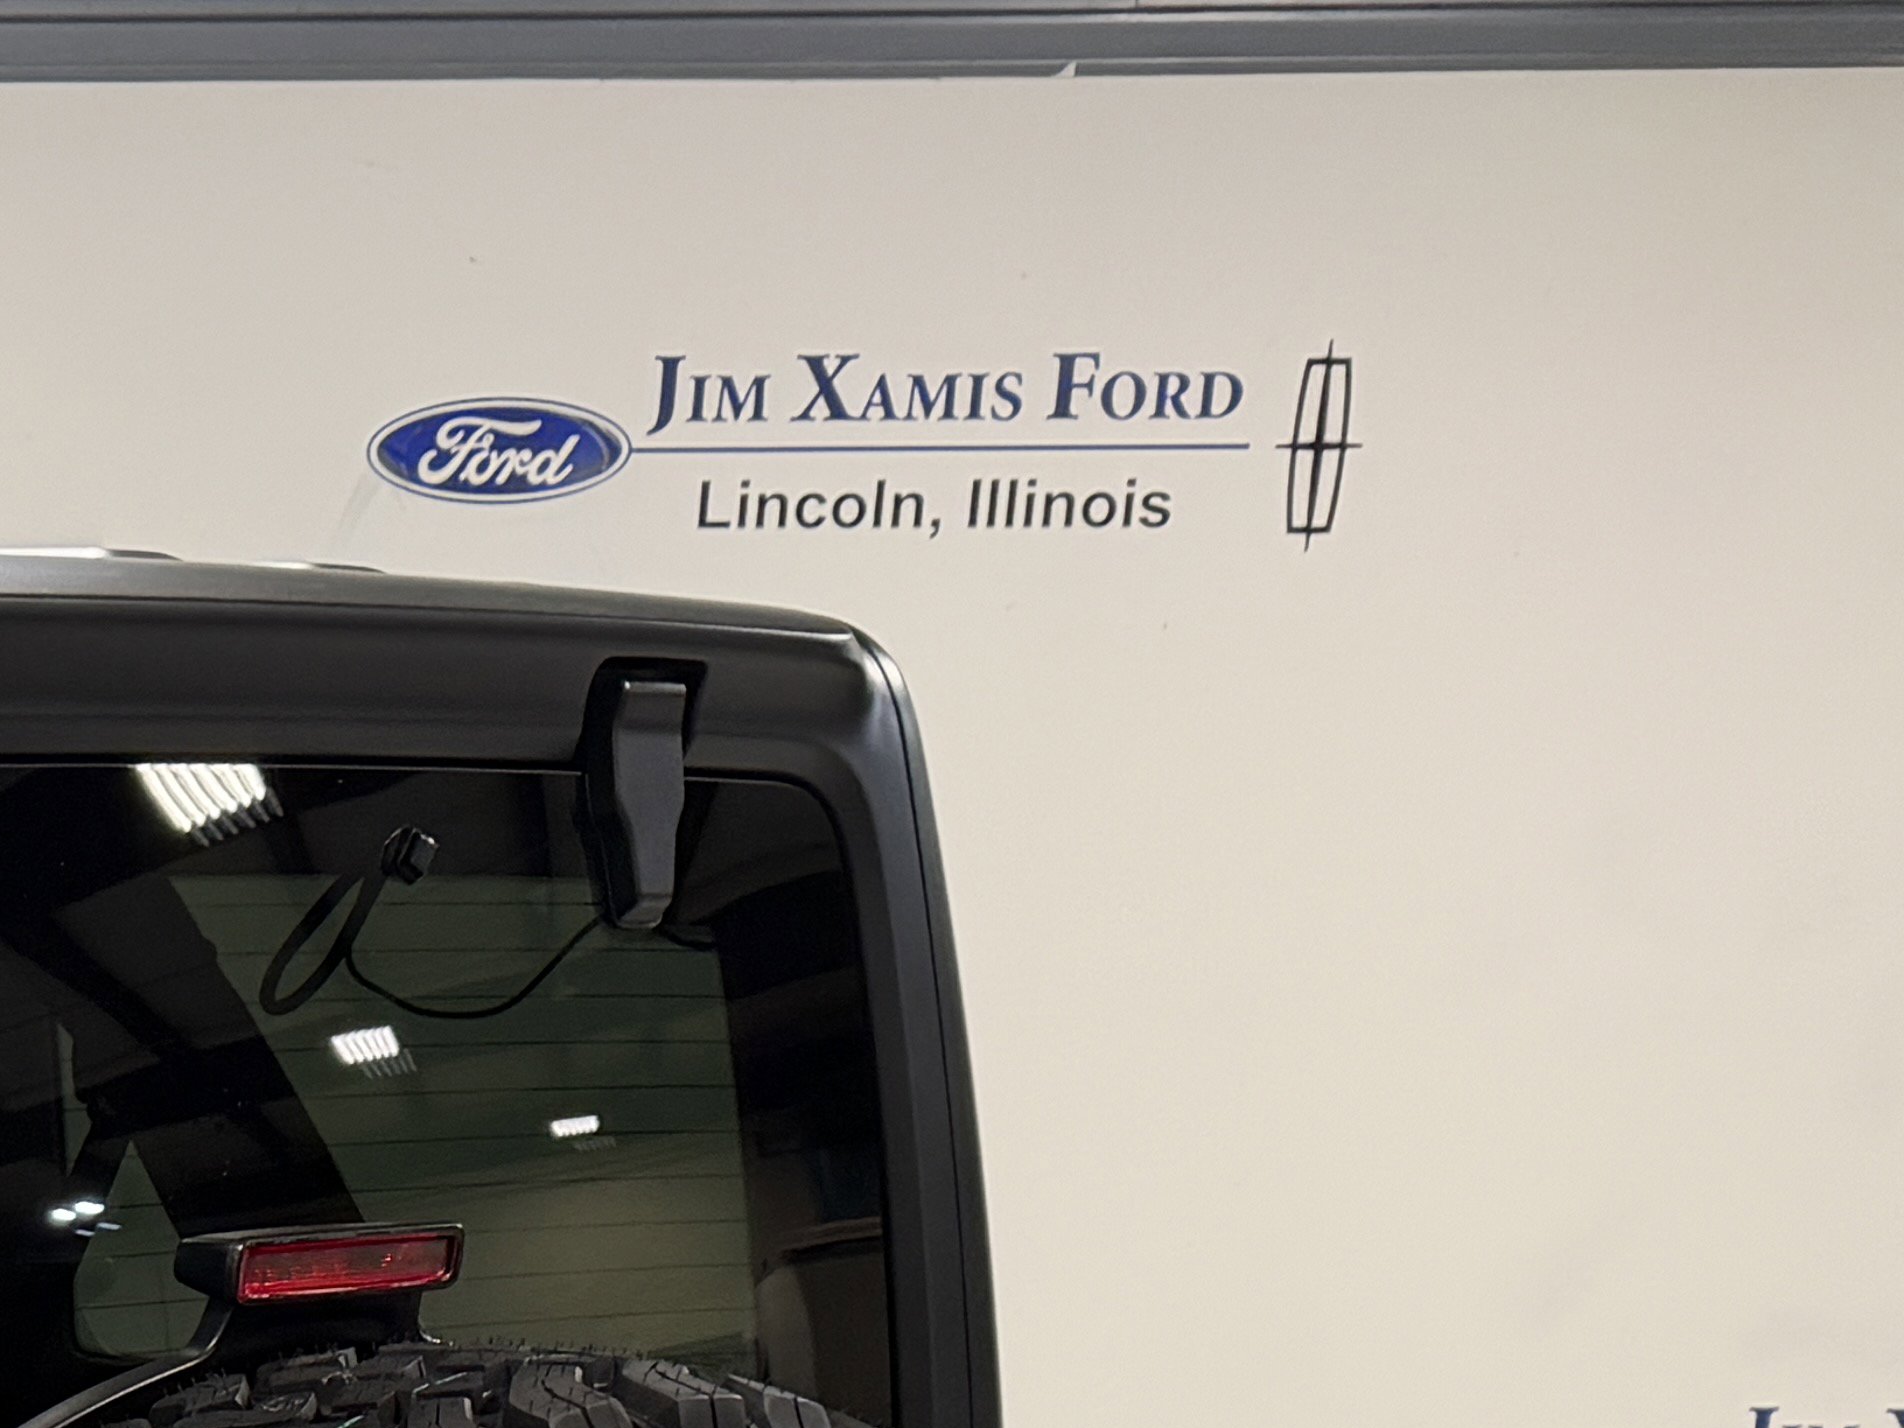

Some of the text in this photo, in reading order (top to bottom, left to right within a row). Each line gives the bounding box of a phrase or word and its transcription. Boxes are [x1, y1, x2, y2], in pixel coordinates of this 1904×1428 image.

[417, 416, 580, 486] Ford
[698, 479, 1171, 538] Lincoln, Illinois
